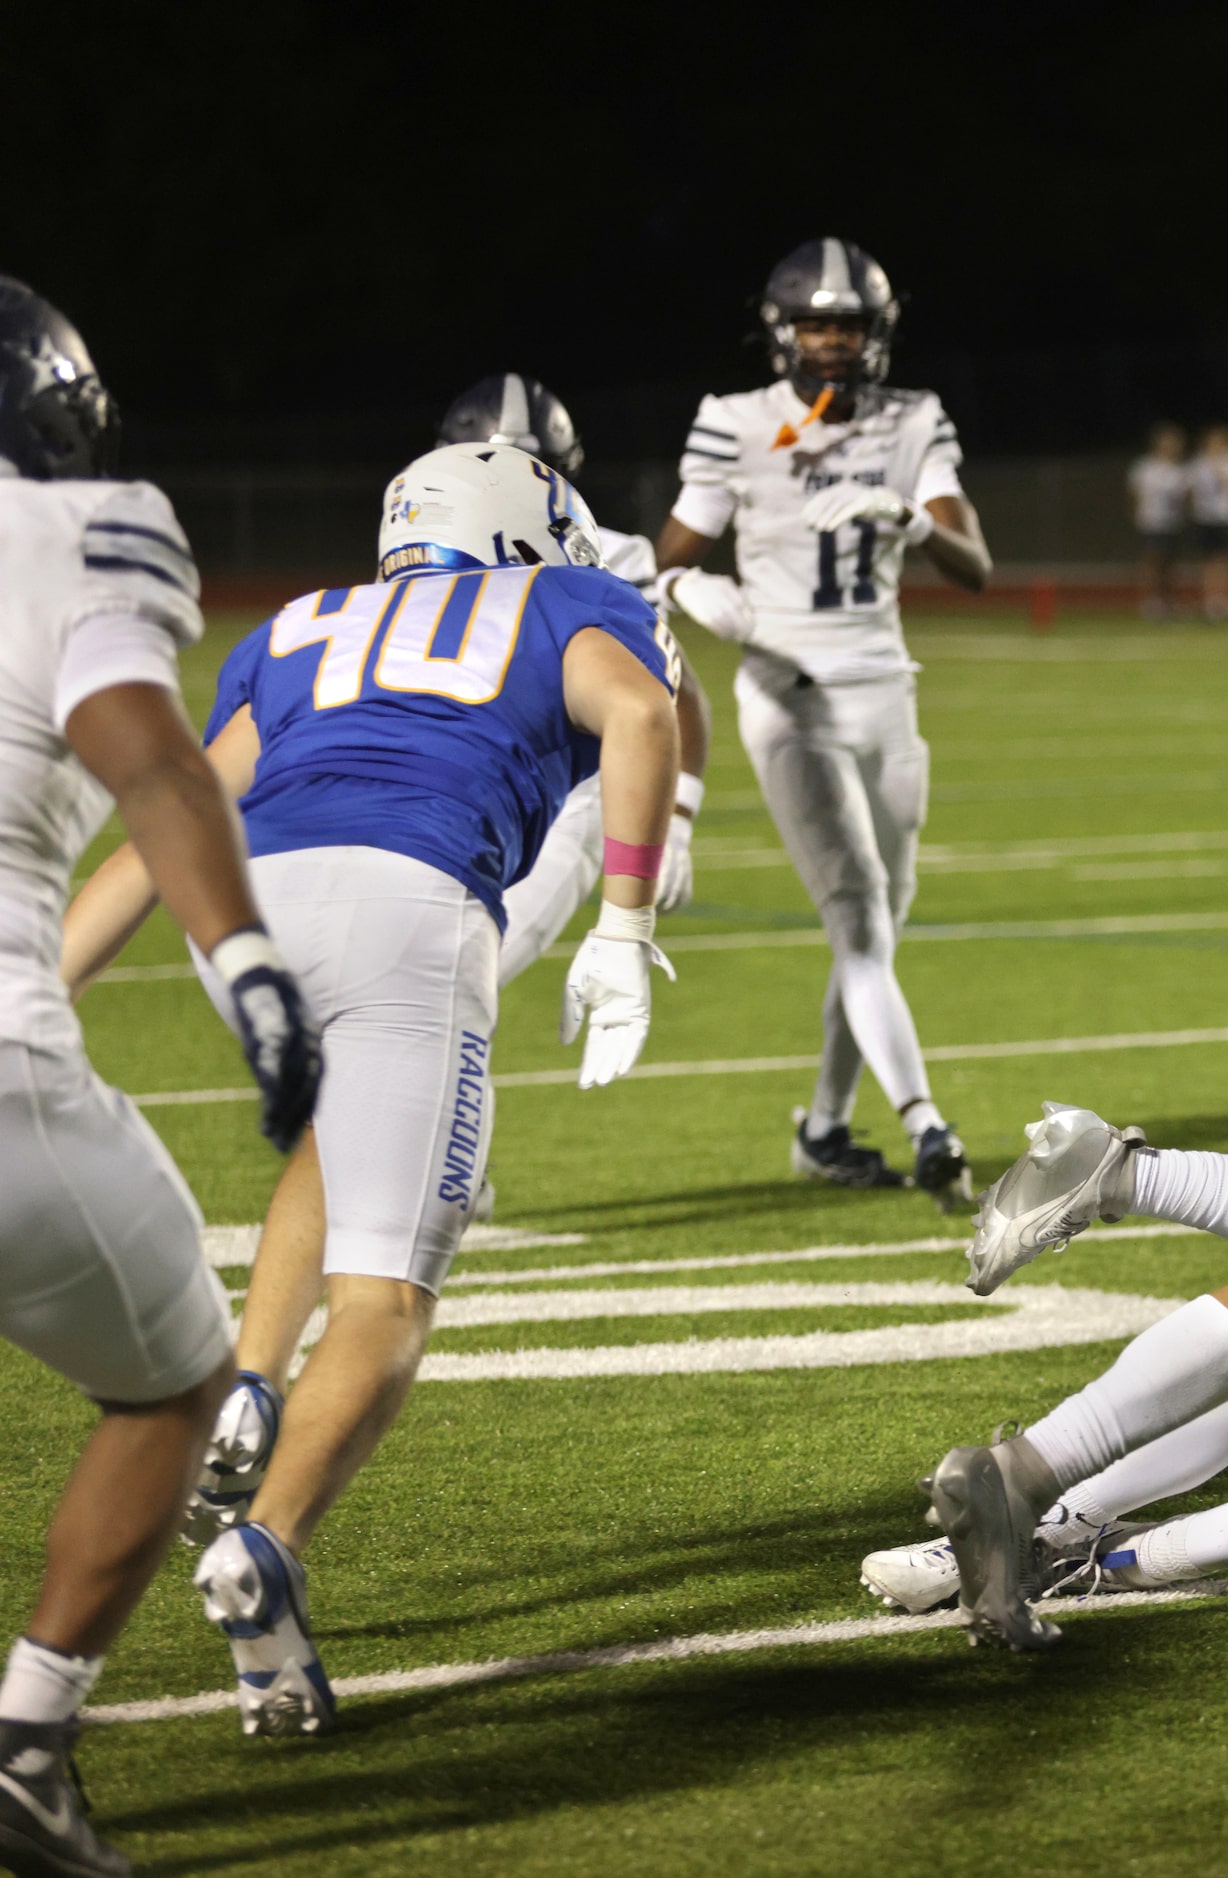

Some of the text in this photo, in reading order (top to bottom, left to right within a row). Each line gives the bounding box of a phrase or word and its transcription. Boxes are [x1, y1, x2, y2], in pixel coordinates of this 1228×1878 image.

[812, 513, 878, 610] 11
[269, 563, 543, 711] 40
[438, 1030, 488, 1212] RACCOONS
